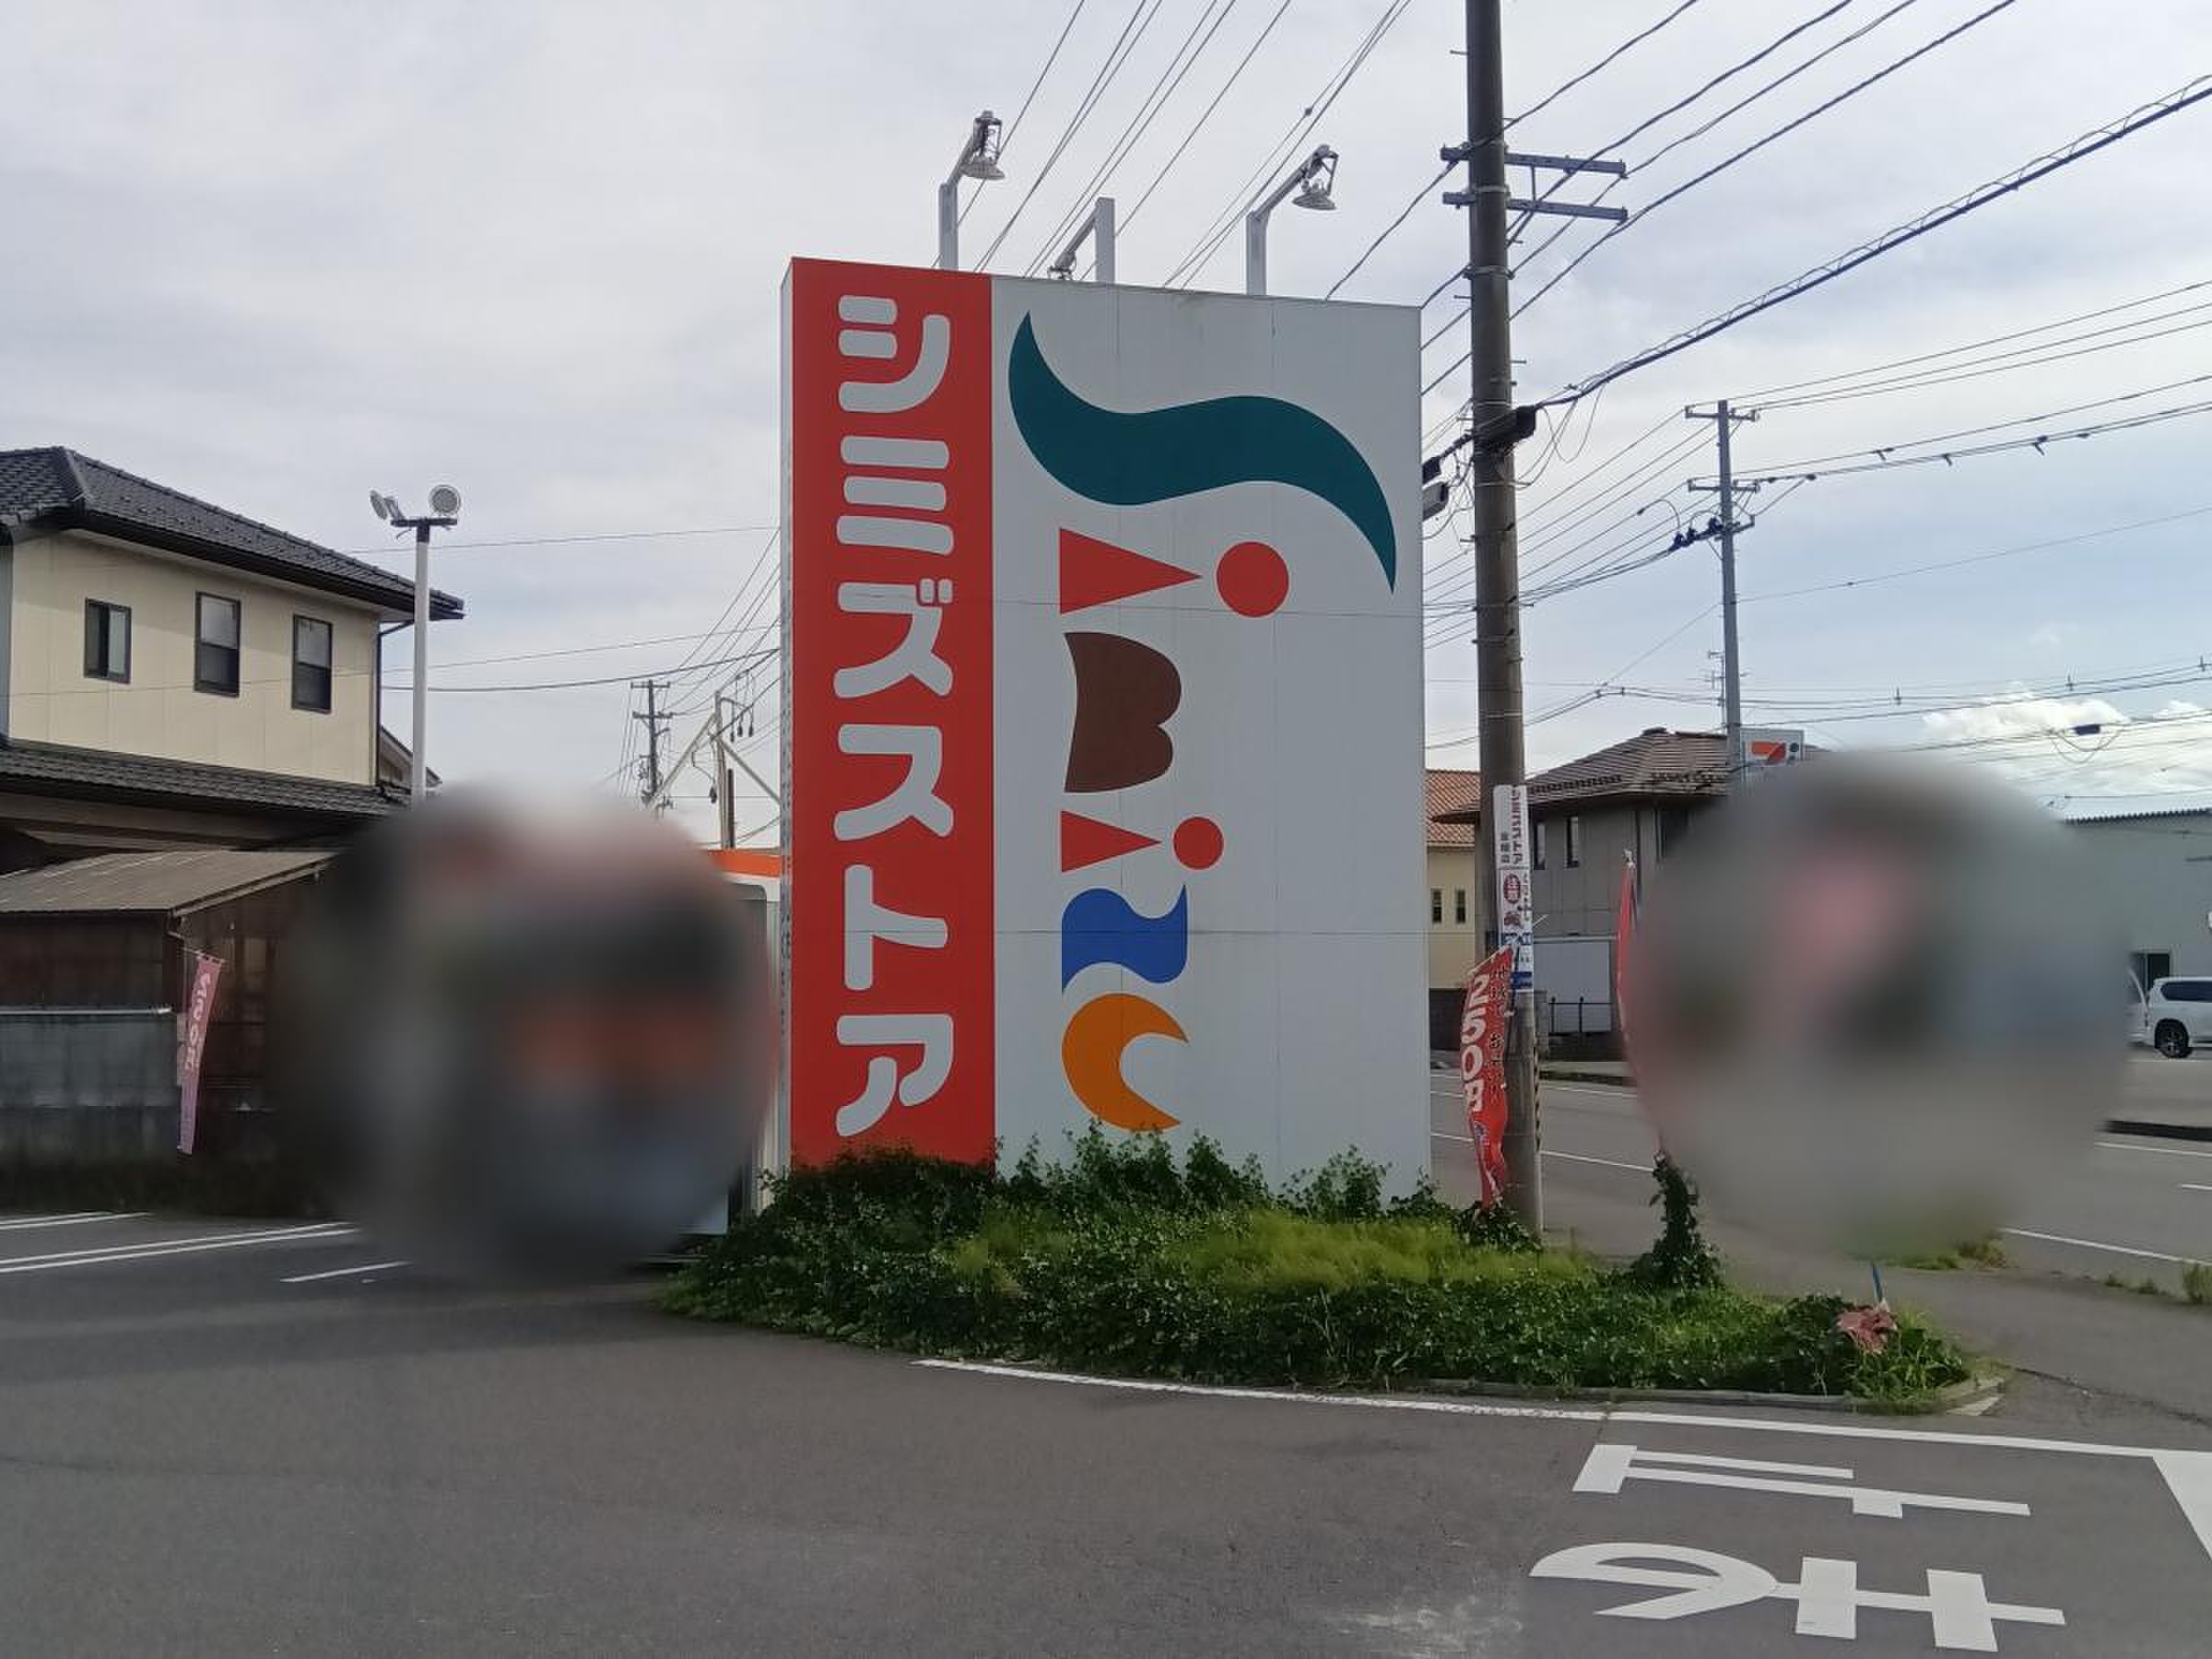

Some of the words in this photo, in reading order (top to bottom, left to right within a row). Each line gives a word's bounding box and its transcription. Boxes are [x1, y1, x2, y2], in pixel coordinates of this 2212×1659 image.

[832, 294, 954, 1136] シミズストア
